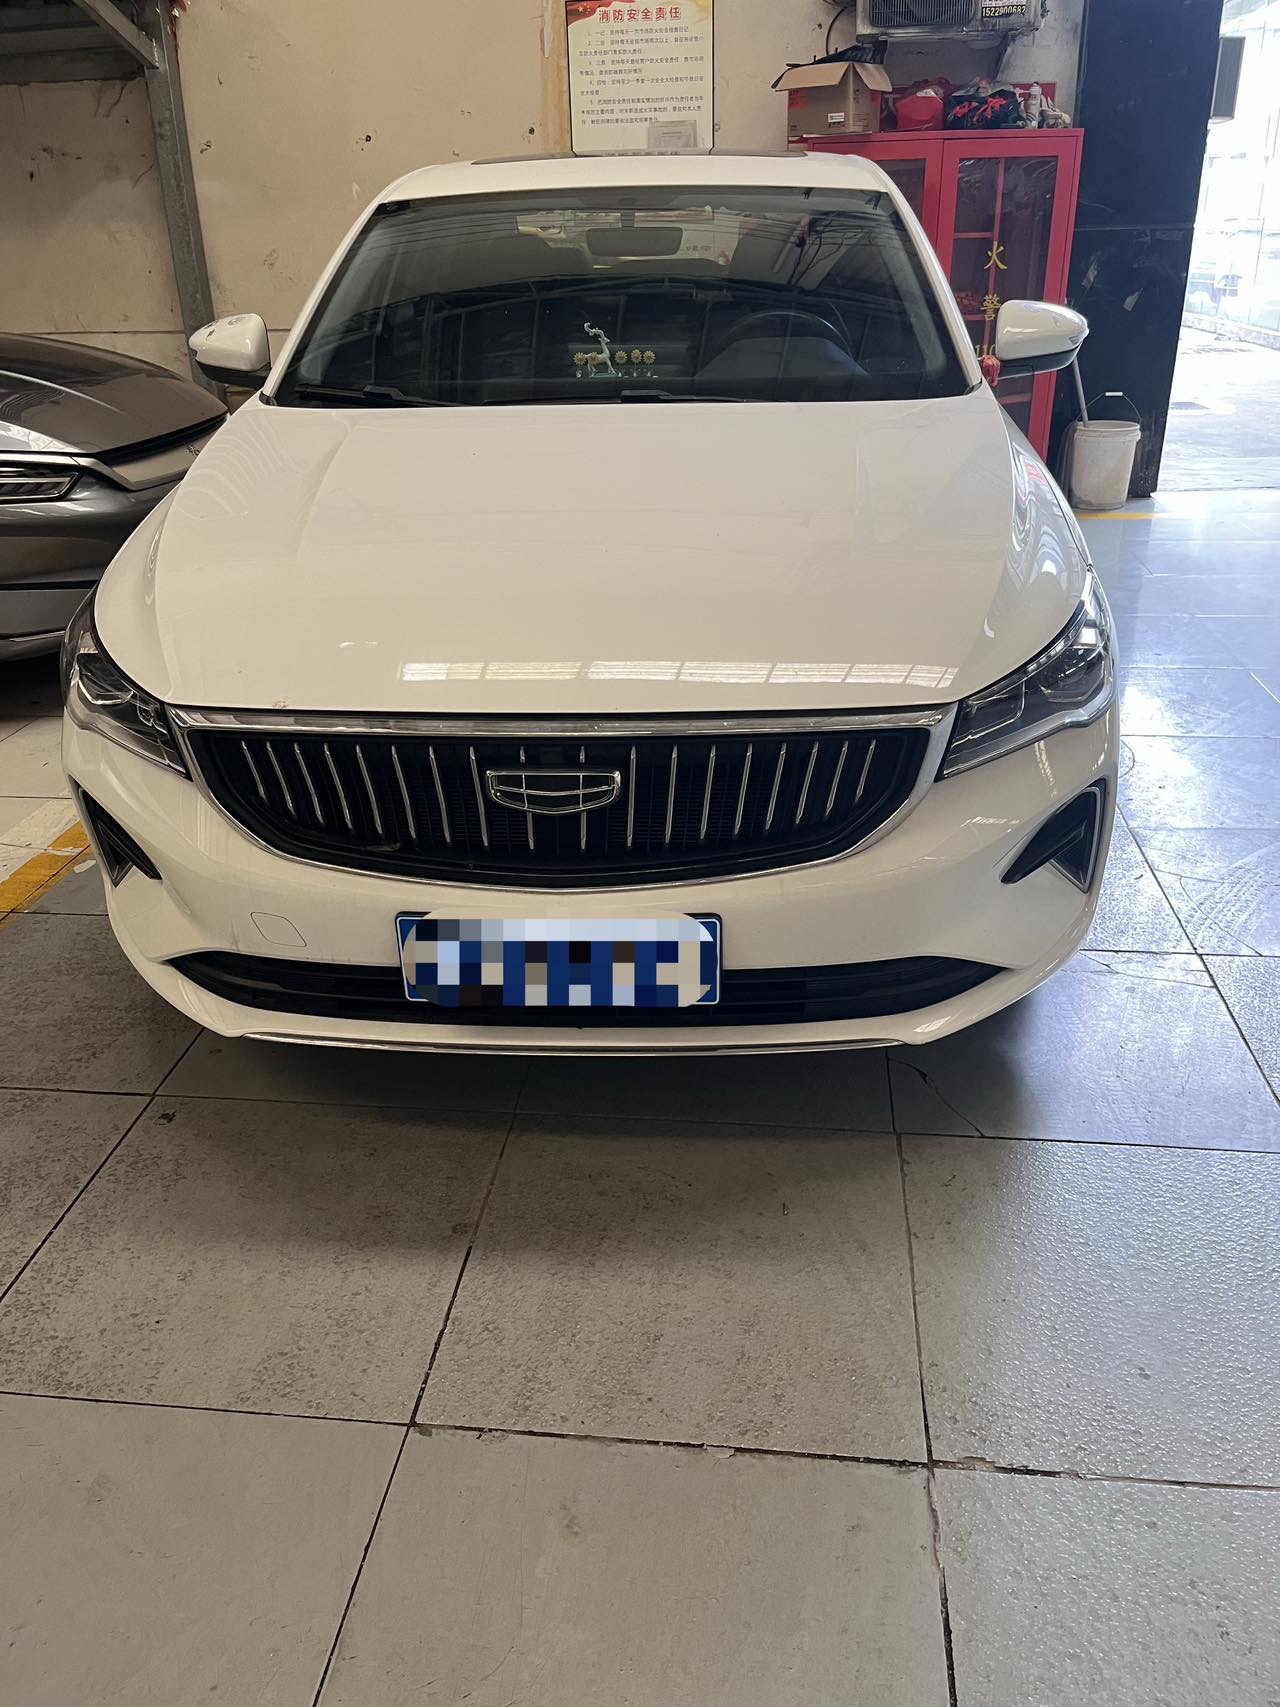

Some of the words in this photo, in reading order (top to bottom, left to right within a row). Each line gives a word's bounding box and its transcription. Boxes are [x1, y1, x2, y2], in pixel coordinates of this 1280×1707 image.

[598, 7, 682, 23] 消防安全责任
[980, 240, 1008, 321] 火警
